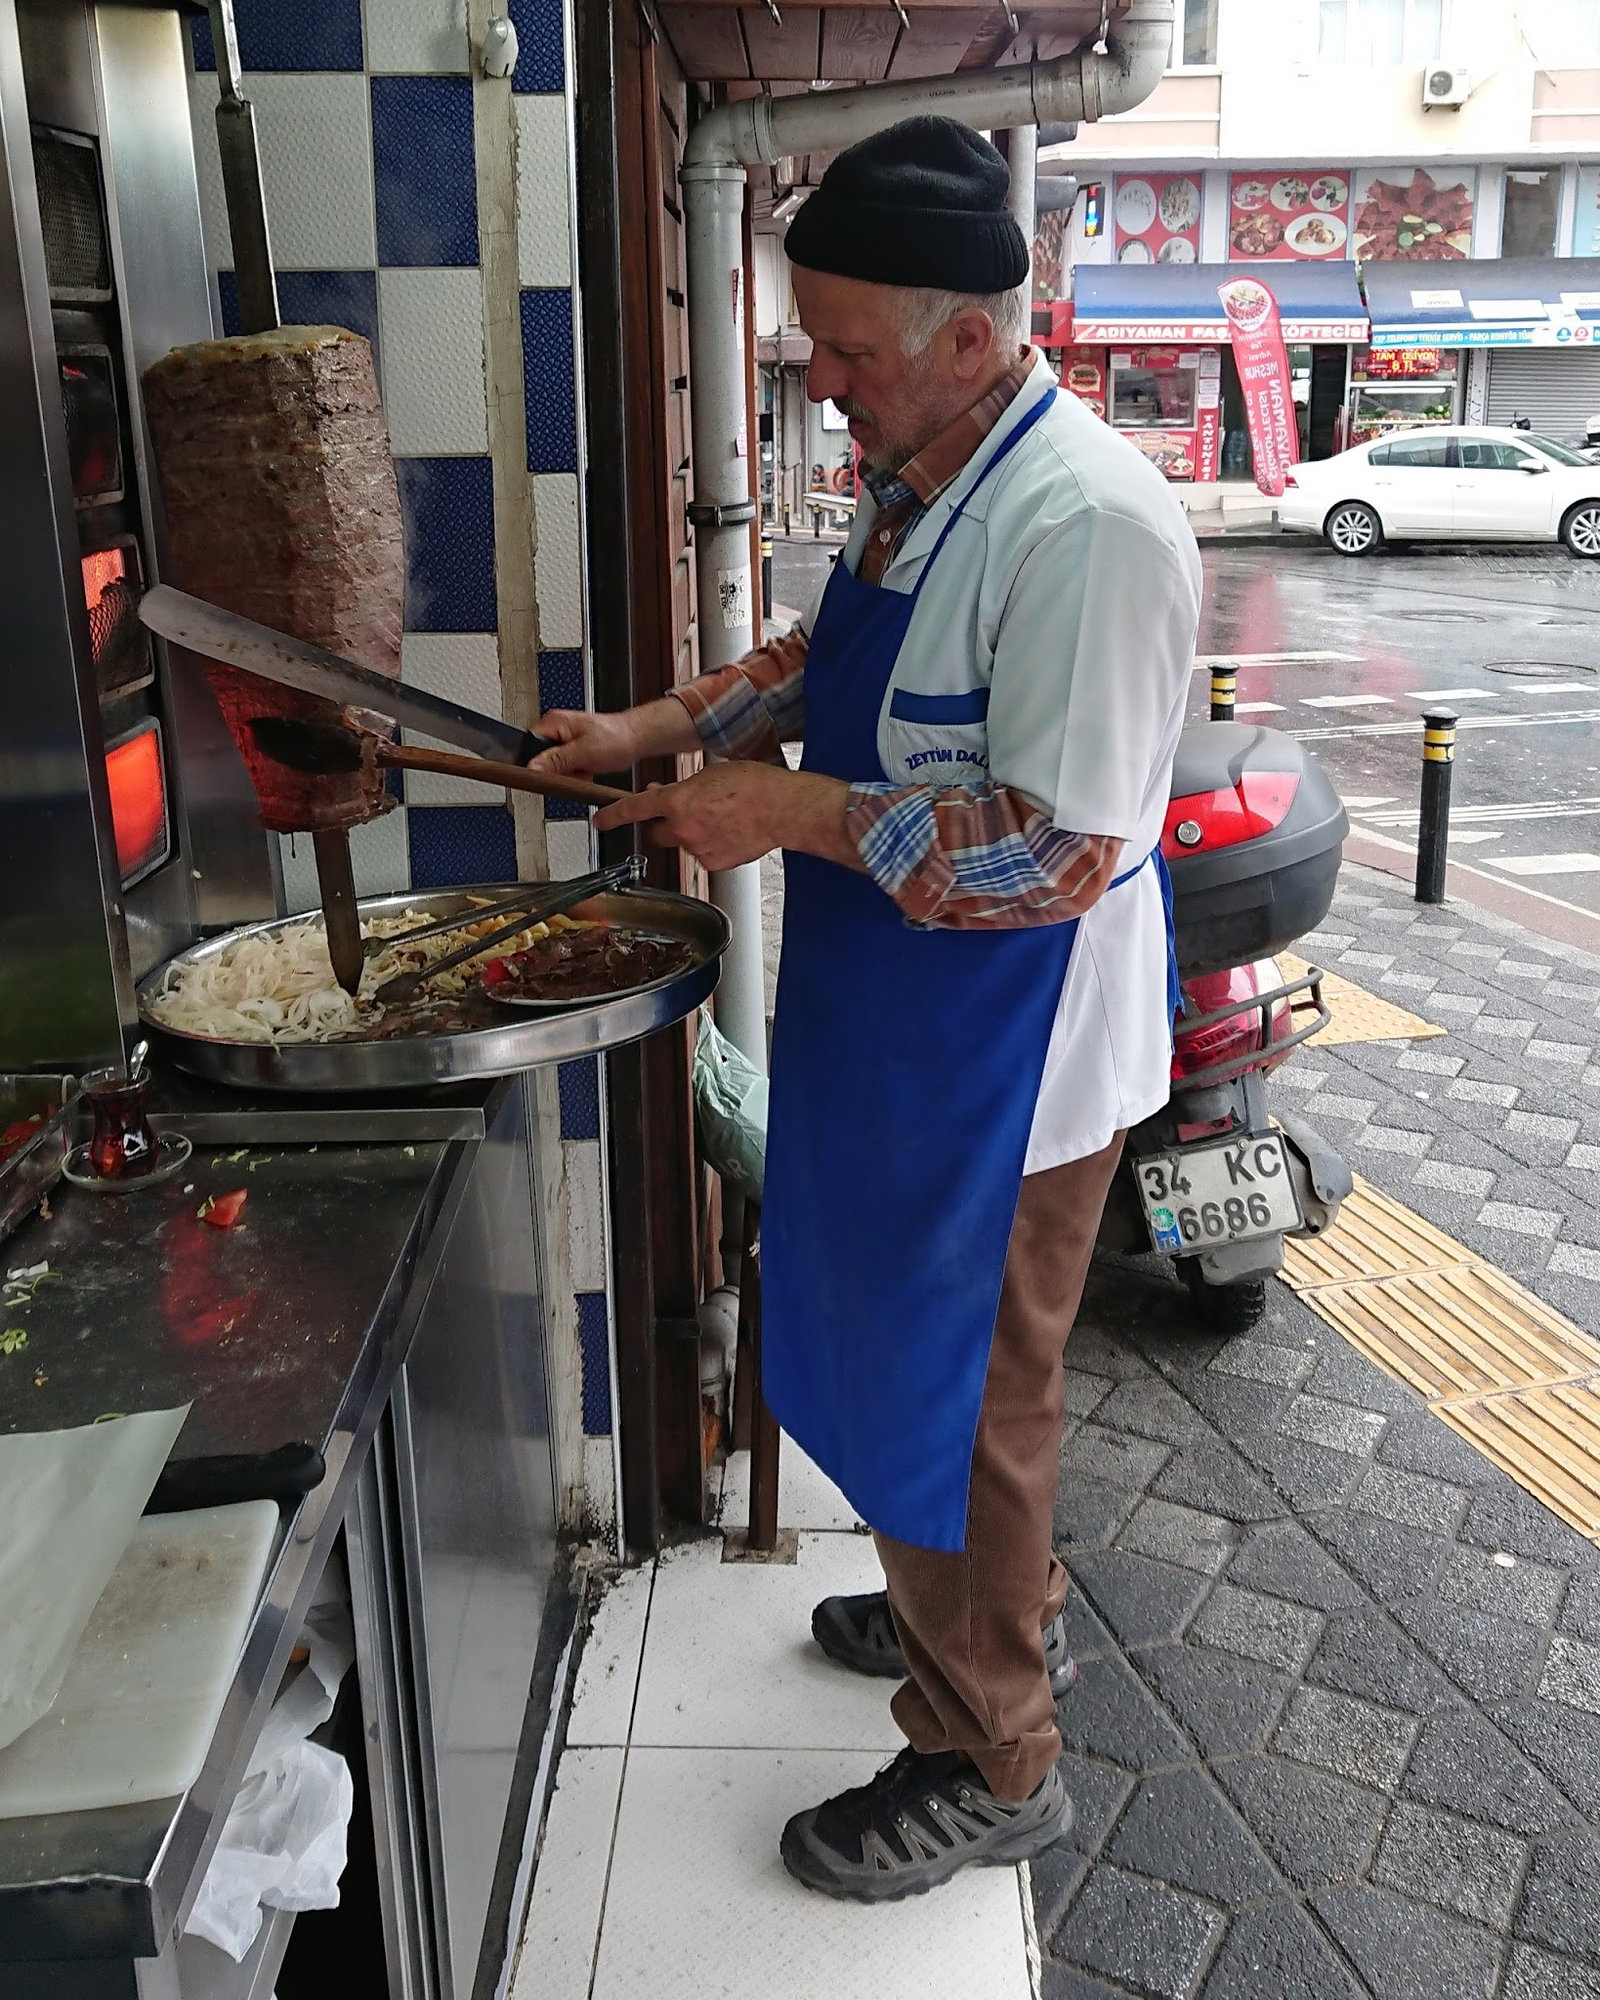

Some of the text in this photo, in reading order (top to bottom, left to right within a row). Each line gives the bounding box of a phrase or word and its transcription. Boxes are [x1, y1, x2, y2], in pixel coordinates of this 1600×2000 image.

[1096, 325, 1186, 339] ADIYAMAN
[905, 746, 952, 770] ZEYTİN
[1145, 1143, 1281, 1201] 34 KC
[1178, 1193, 1272, 1242] 6686
[1160, 1234, 1179, 1249] TR
